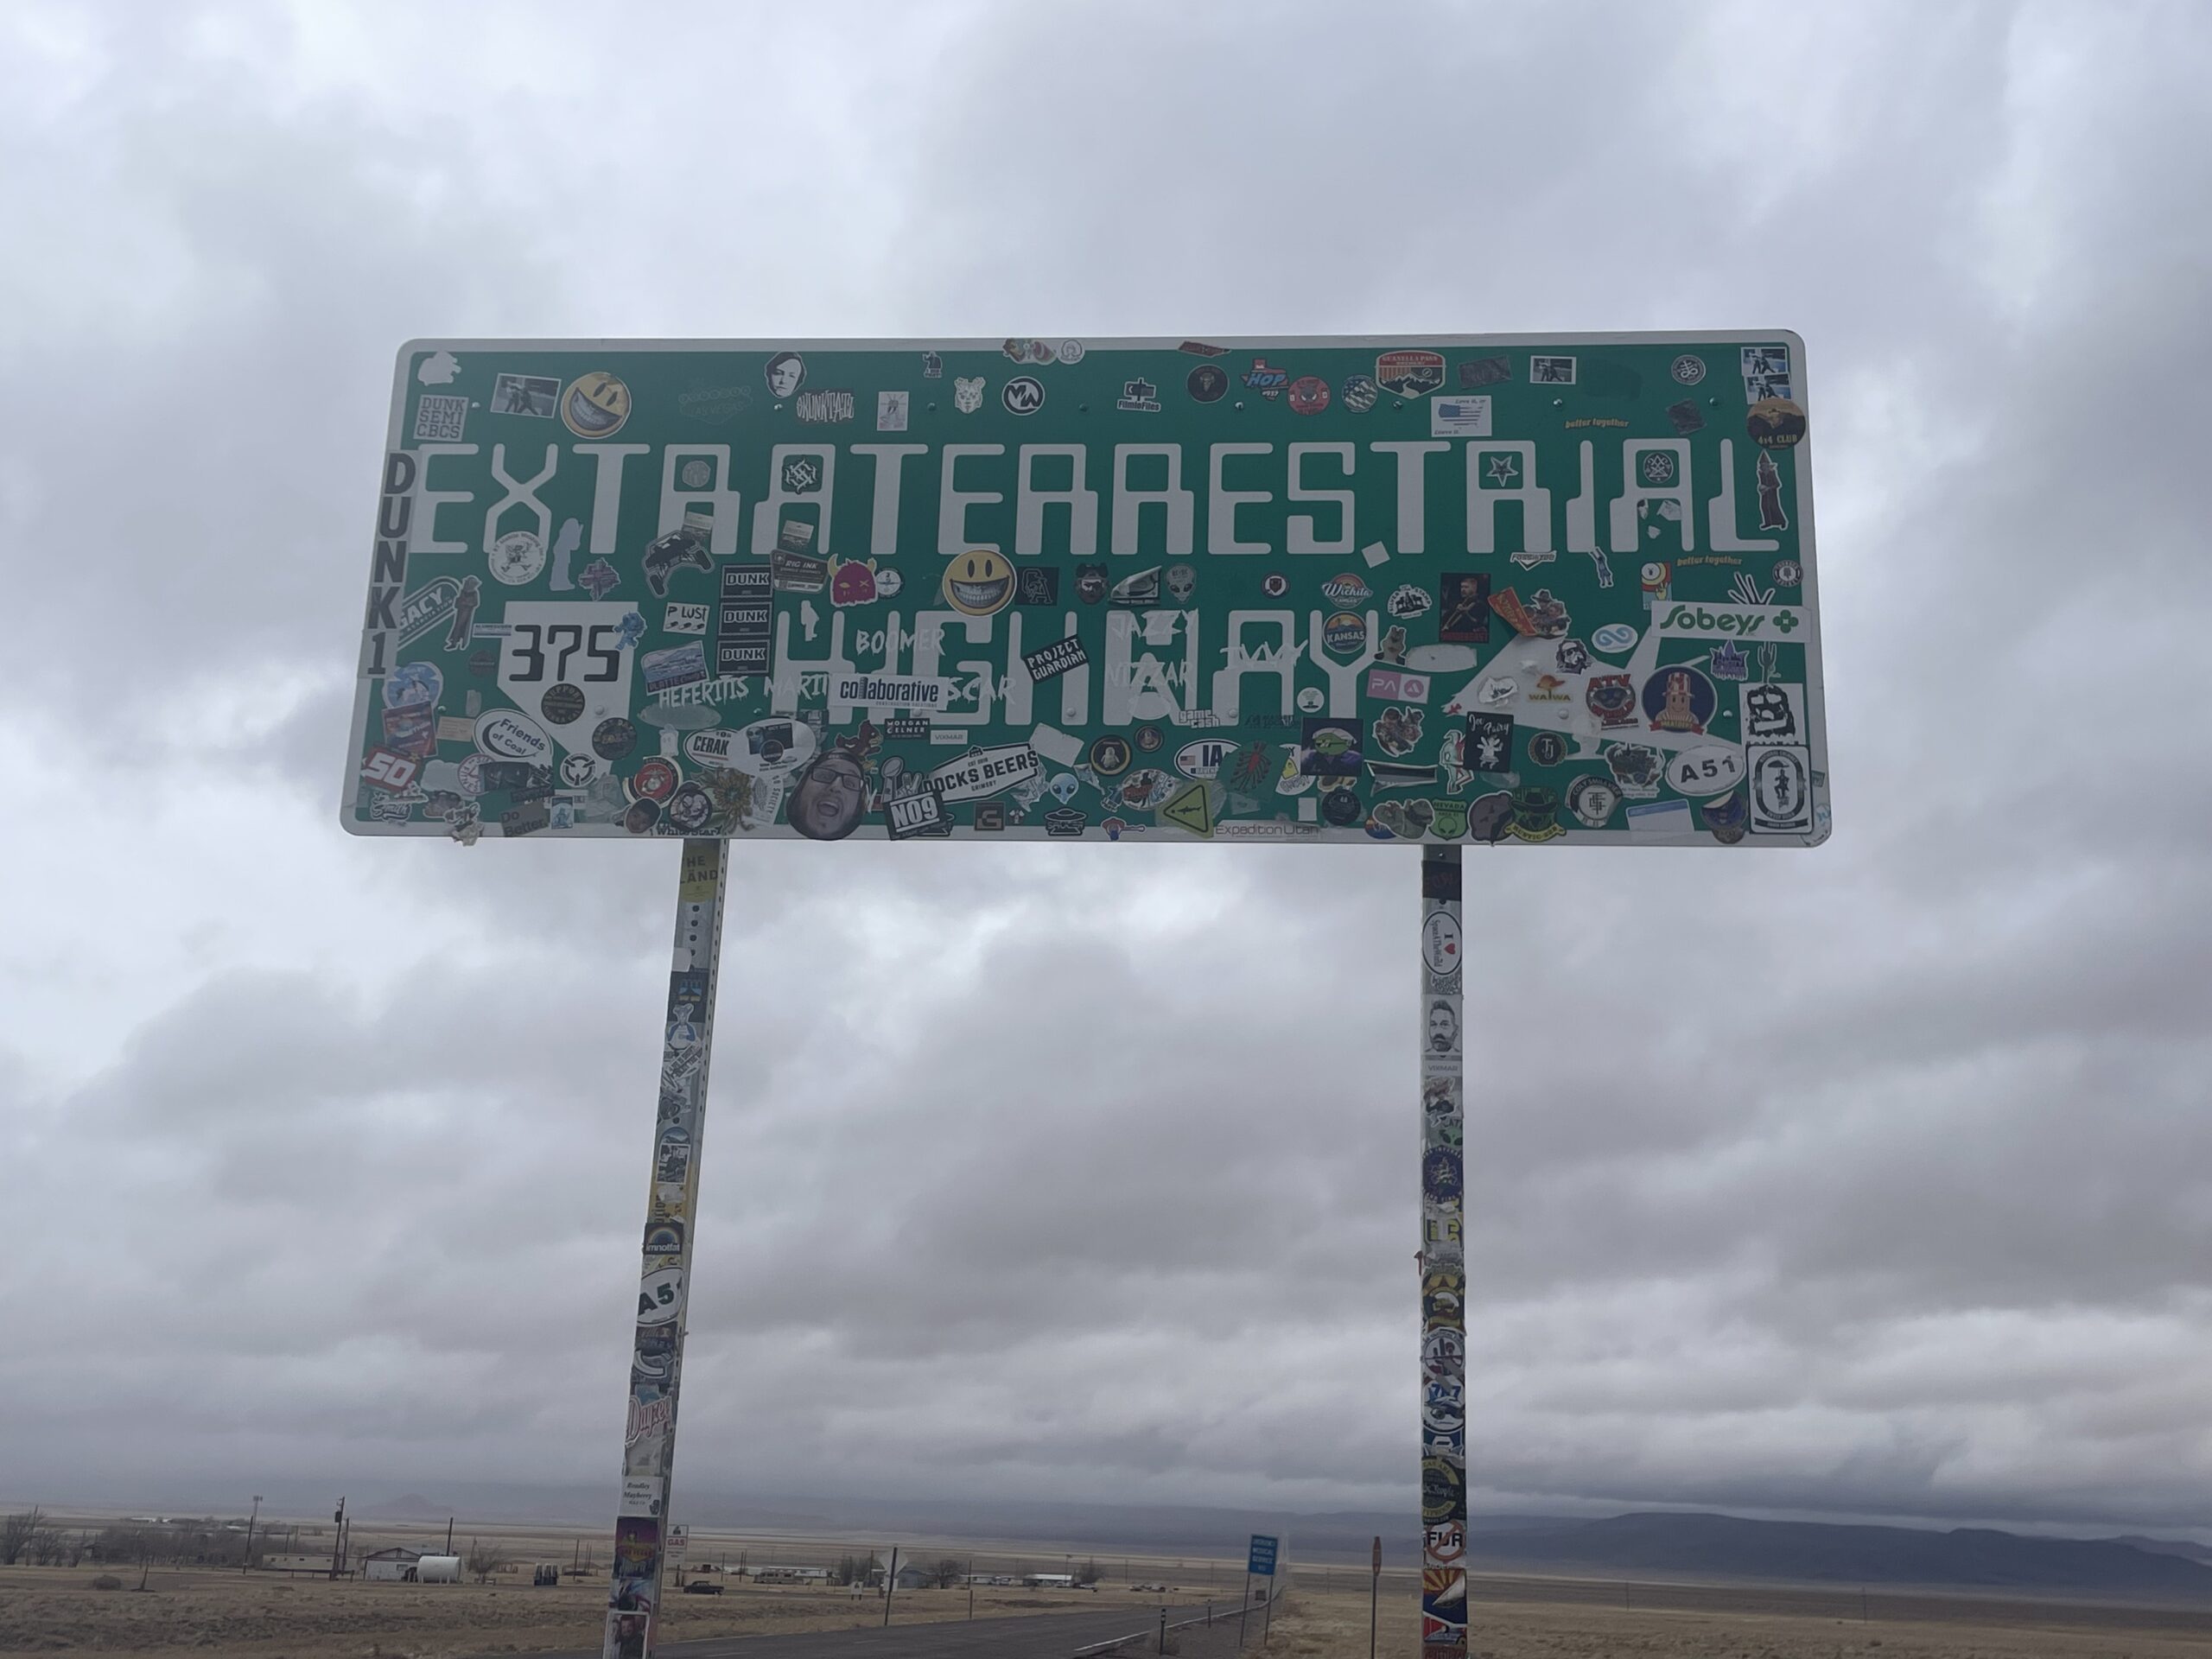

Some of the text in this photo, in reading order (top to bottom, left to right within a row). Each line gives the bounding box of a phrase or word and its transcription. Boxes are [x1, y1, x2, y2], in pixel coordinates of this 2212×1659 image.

[1247, 375, 1287, 388] HOP
[421, 397, 466, 411] DUNK
[419, 410, 463, 424] SEMI
[416, 423, 461, 438] CBCS
[410, 439, 1780, 557] EXTRATERRESTRIAL
[727, 573, 771, 585] DUNK
[724, 610, 768, 622] DUNK
[1660, 605, 1764, 636] Sobeys
[1326, 630, 1365, 644] KANSAS
[508, 624, 620, 683] 375
[721, 648, 766, 662] DUNK
[1588, 674, 1631, 689] ATV
[840, 678, 939, 702] collaborative
[499, 718, 546, 752] Friends
[493, 732, 526, 755] of Coal
[694, 735, 729, 755] CERAK
[982, 750, 1039, 777] BEERS
[1680, 755, 1736, 783] A51
[1433, 801, 1465, 810] NEVADA
[501, 810, 518, 822] Do
[682, 855, 705, 867] HE
[668, 1538, 685, 1547] GAS
[1427, 1531, 1462, 1548] FUR
